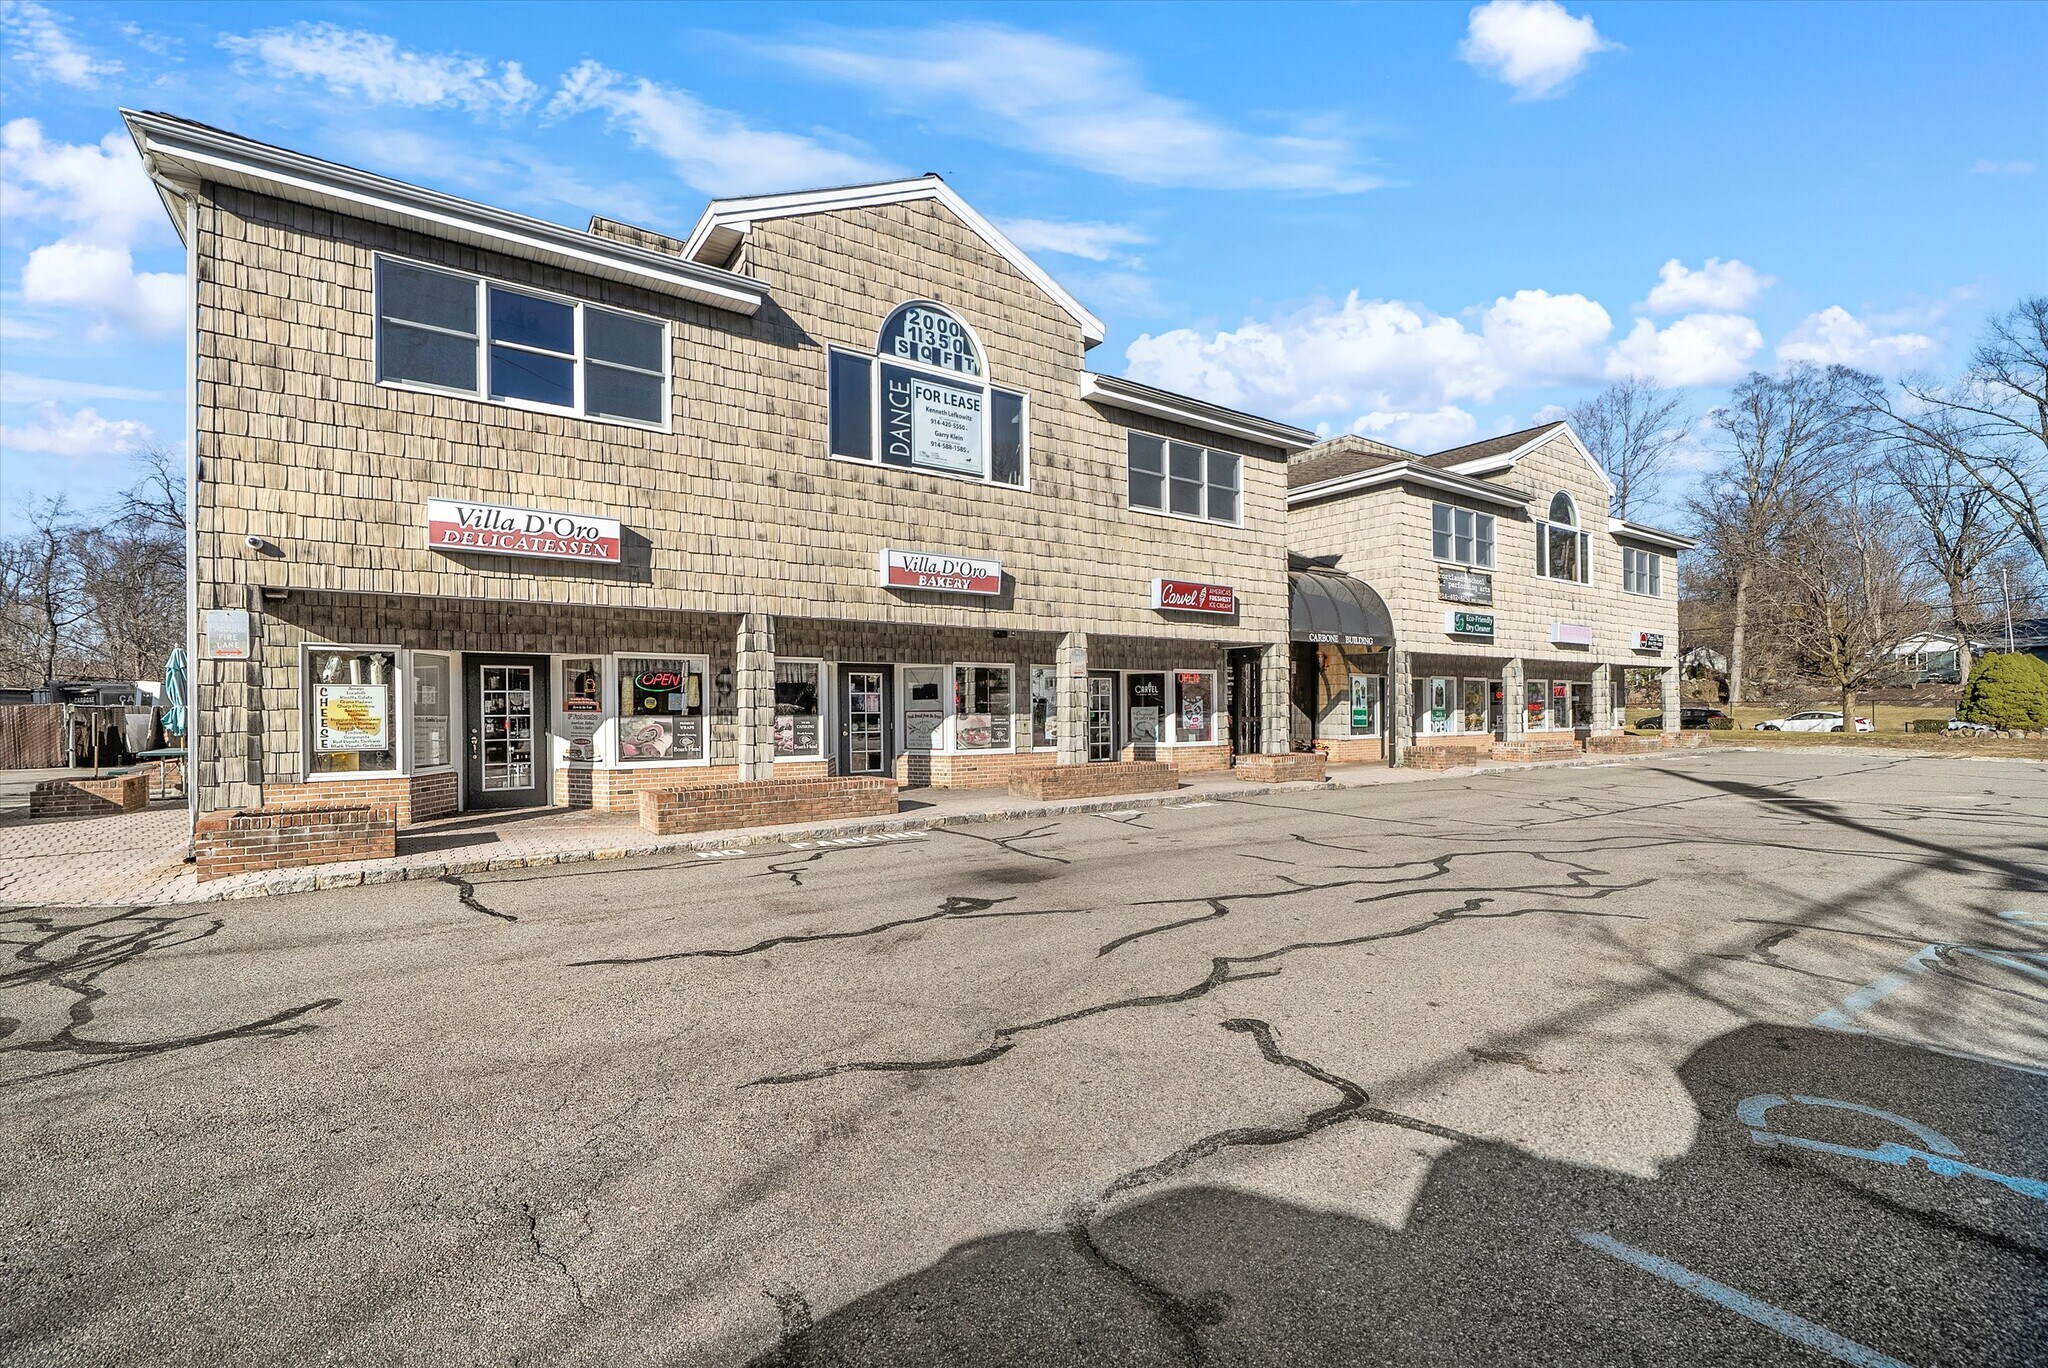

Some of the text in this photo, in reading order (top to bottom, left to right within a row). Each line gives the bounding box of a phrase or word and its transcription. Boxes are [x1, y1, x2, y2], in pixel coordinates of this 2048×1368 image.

[909, 311, 960, 337] 2000
[915, 386, 981, 412] FOR LEASE
[889, 379, 911, 457] DANCE
[925, 406, 948, 416] Kenneth
[948, 411, 973, 422] Lefkowitz
[934, 430, 950, 440] Garry
[455, 506, 599, 540] Villa D'Oro
[442, 529, 609, 557] DELICATESSEN
[903, 555, 987, 578] Villa D'Oro
[918, 575, 971, 590] BAKERY
[1162, 583, 1198, 606] Carvel
[1208, 595, 1232, 603] FRESHEST
[1465, 615, 1493, 625] Eco-Friendly
[1465, 624, 1491, 632] Dry Cleaner
[218, 633, 238, 641] FIRE
[1309, 633, 1374, 645] CARBONE BUILDING
[216, 641, 240, 649] LANE
[642, 673, 681, 686] OPEN
[1177, 673, 1200, 684] OPEN
[1134, 682, 1159, 694] CARVEL
[319, 687, 329, 749] CHEESE
[695, 830, 928, 858] NO PARKING
